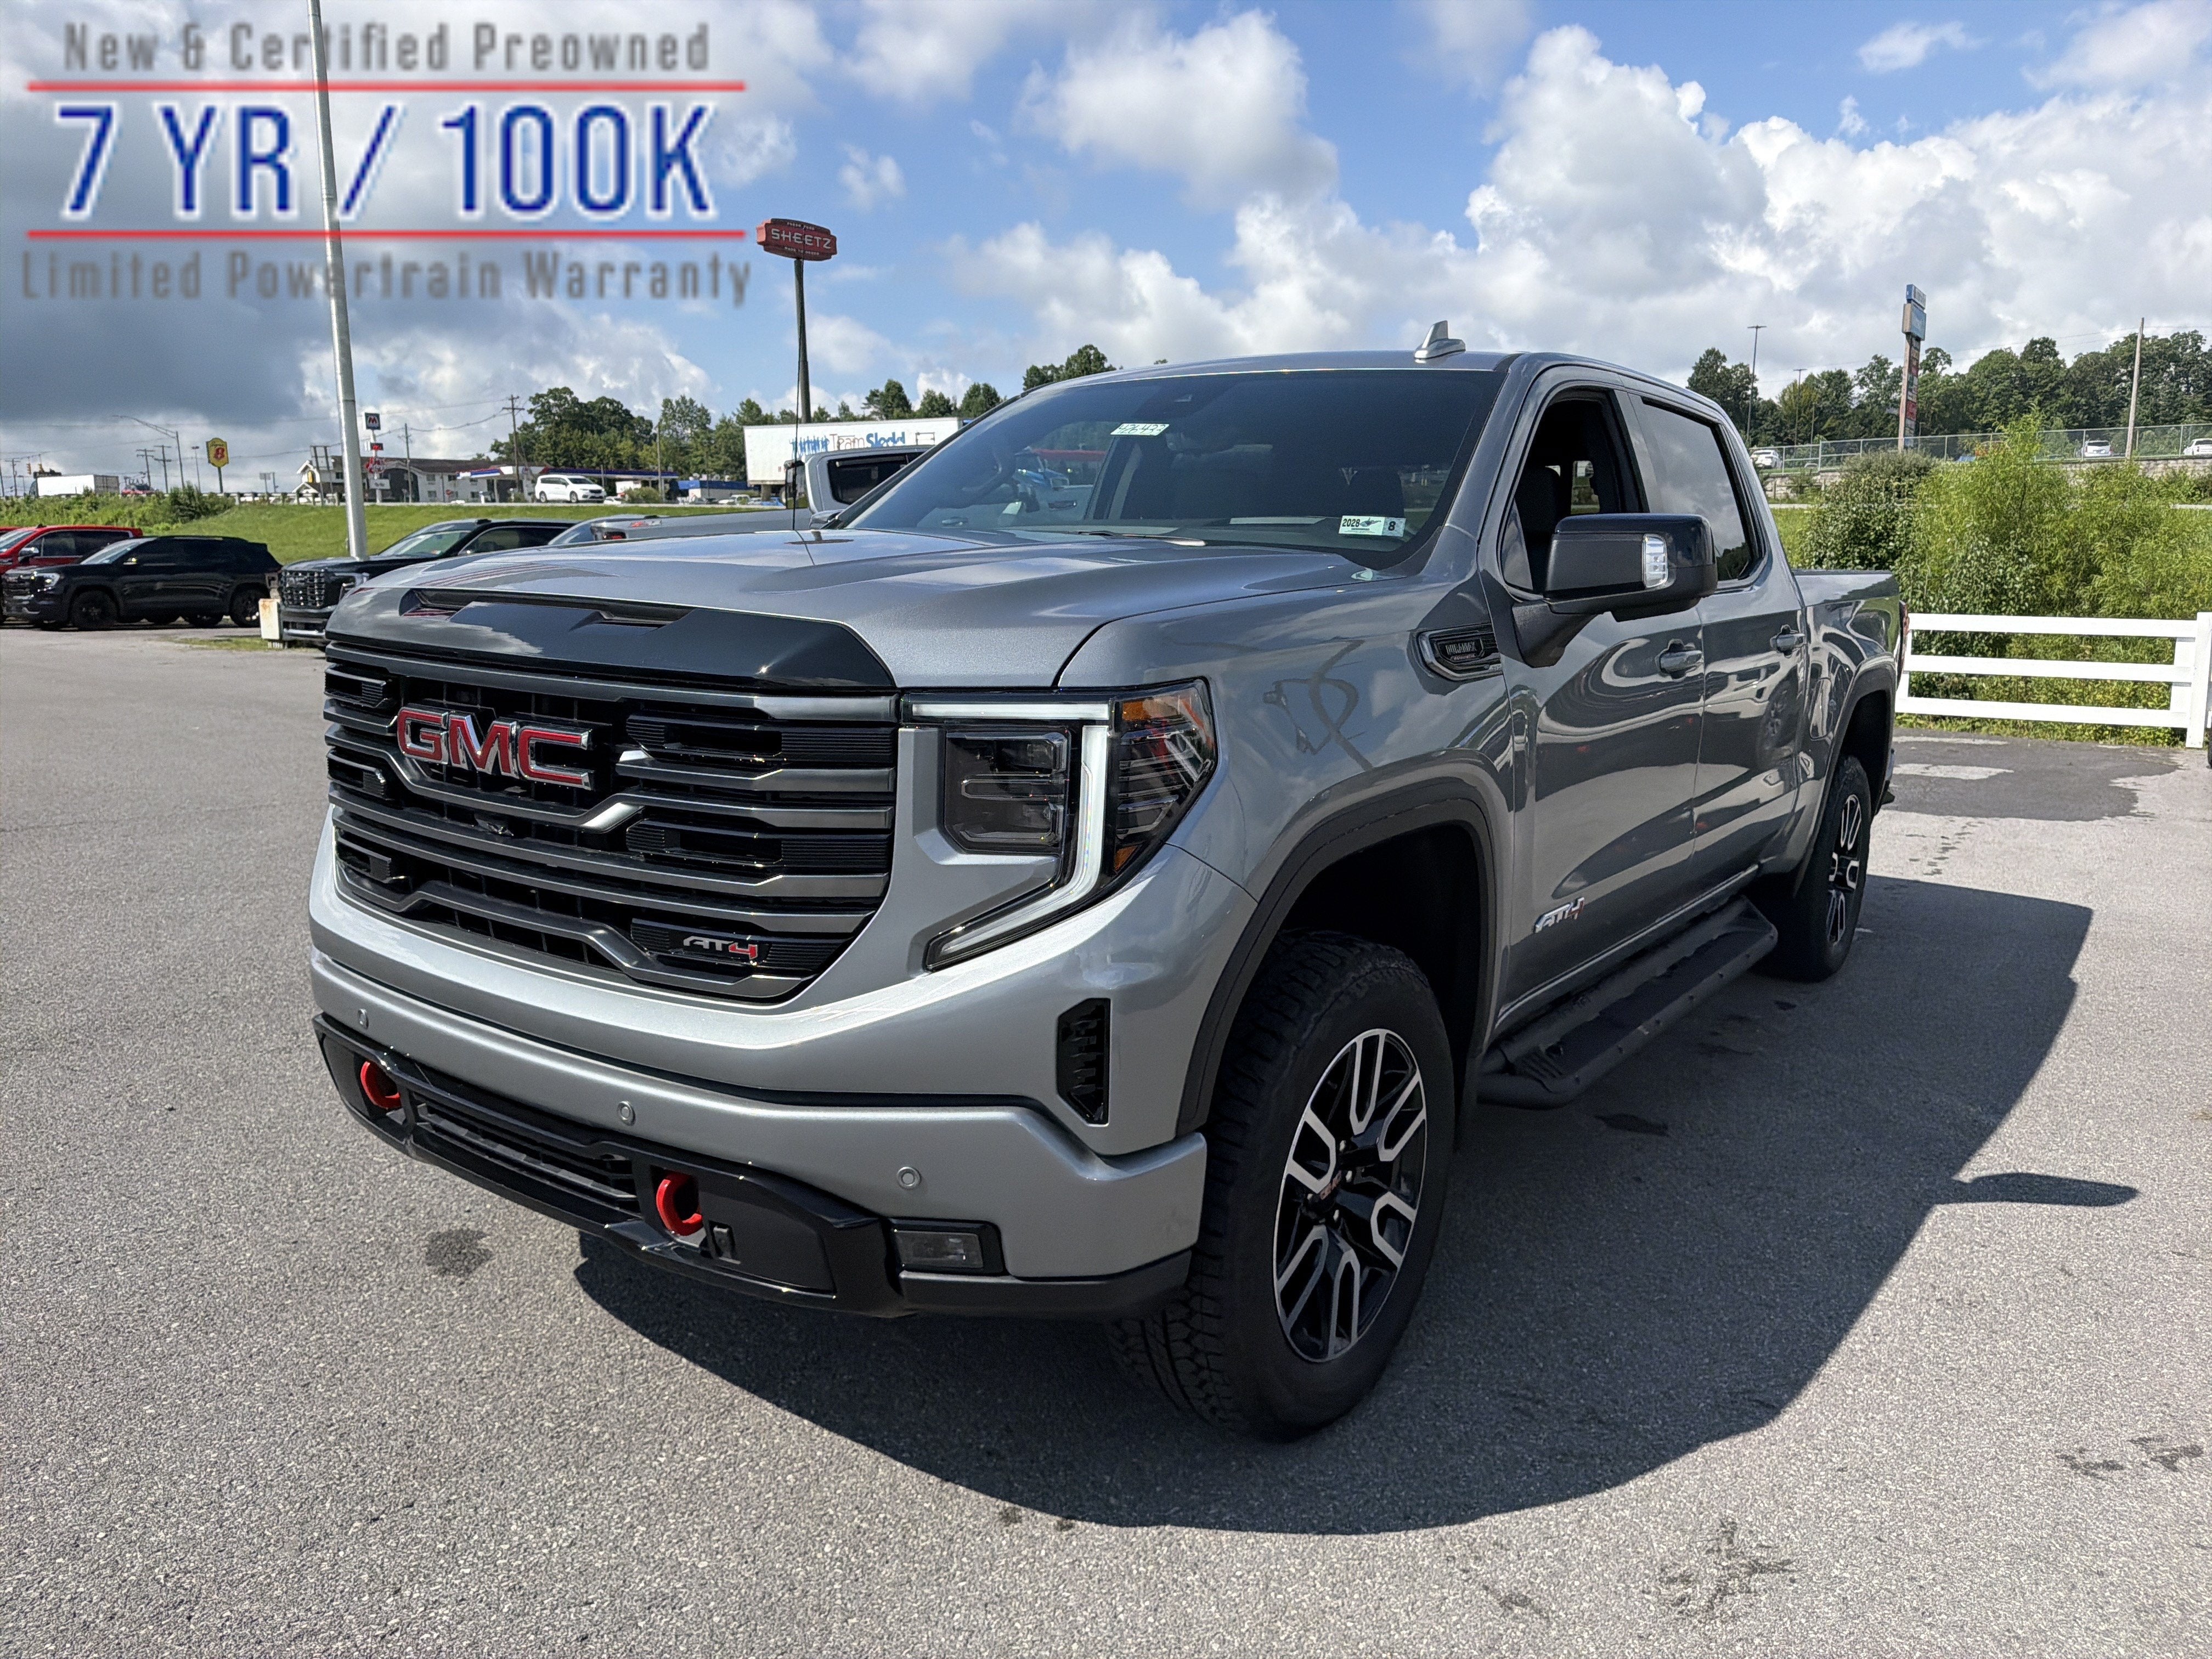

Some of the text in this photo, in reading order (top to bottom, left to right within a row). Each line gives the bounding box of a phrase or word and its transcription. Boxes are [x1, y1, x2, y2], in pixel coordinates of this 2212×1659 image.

[771, 228, 831, 249] SHEETZ
[830, 433, 865, 450] Team
[1342, 518, 1360, 527] 2028
[1388, 521, 1396, 531] 8
[397, 706, 594, 790] GMC
[1536, 897, 1584, 933] AT4
[683, 935, 758, 960] AT4
